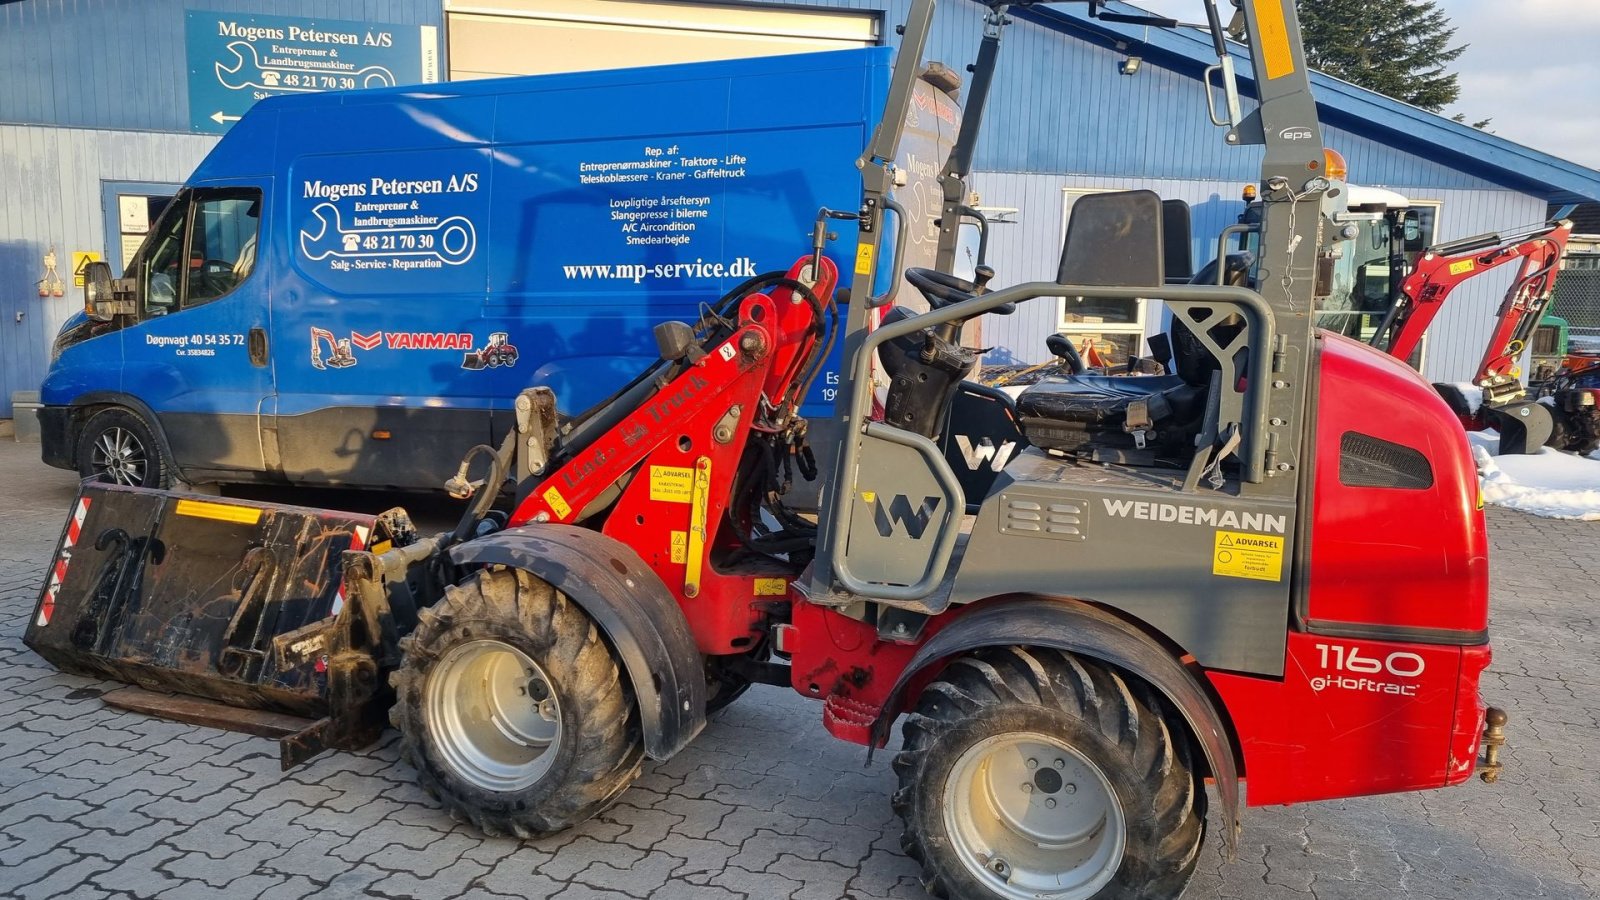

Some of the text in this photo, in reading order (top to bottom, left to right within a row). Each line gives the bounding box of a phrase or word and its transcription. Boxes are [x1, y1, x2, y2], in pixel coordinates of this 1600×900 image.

[218, 21, 392, 47] Mogens Petersen A/S
[329, 49, 338, 57] &
[263, 56, 355, 70] Landbrugsmaskiner
[283, 74, 355, 89] 48 21 70 30
[253, 91, 272, 100] Sal
[1283, 131, 1312, 141] eps
[645, 145, 680, 157] Rep. af:
[580, 159, 671, 172] Entreprenørmaskiner
[680, 156, 718, 167] Traktore
[725, 154, 747, 166] Lifte
[580, 173, 648, 184] Teleskoblæssere
[656, 171, 686, 181] Kraner
[693, 168, 746, 179] Gaffeltruck
[303, 173, 478, 201] Mogens Petersen A/S
[410, 200, 419, 210] &
[609, 195, 711, 208] Lovpligtige årseftersyn
[354, 215, 439, 227] landbrugsmaskiner
[611, 210, 669, 221] Slangepresse
[676, 208, 708, 218] bilerne
[622, 222, 696, 233] A/C Aircondition
[362, 234, 434, 250] 48 21 70 30
[626, 235, 690, 245] Smedearbejde
[563, 257, 757, 283] www.mp-service.dk
[146, 334, 245, 347] Døgnvagt 40 54 35 72
[385, 332, 474, 350] YANMAR
[826, 371, 840, 385] Es
[644, 374, 709, 423] Truck
[1102, 498, 1286, 533] WEIDEMANN
[1235, 537, 1279, 549] ADVARSEL
[1315, 643, 1426, 678] 1160
